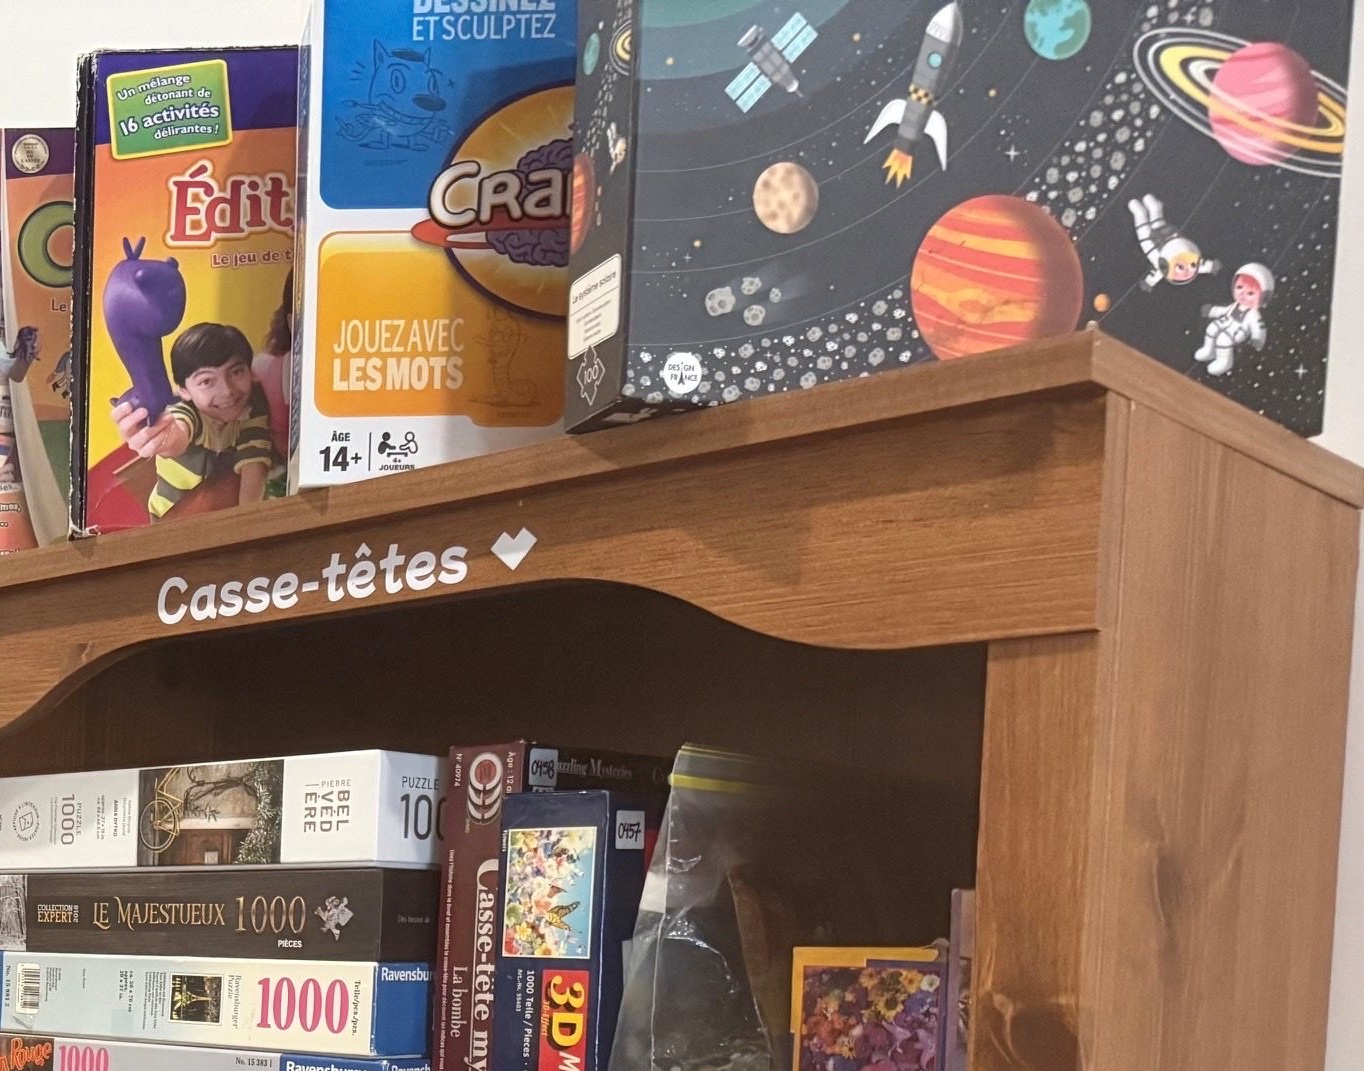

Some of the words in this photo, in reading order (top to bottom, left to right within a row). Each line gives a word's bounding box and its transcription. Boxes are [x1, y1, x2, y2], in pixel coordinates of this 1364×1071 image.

[413, 17, 439, 40] ET
[442, 14, 556, 40] SCULPTEZ
[118, 88, 136, 101] Un
[138, 74, 191, 93] mélange
[144, 89, 194, 106] détonant
[198, 88, 211, 98] de
[119, 119, 138, 136] 16
[143, 103, 220, 128] activités
[233, 252, 257, 267] jeu
[334, 318, 405, 354] JOUEZ
[408, 317, 463, 351] AVEC
[333, 358, 382, 391] LES
[386, 355, 463, 389] MOTS
[331, 430, 350, 441] ÂGE
[319, 446, 362, 472] 14+
[157, 542, 468, 626] Casse-têtes
[589, 758, 632, 778] Mysteries
[320, 779, 351, 788] PIERRE
[61, 794, 75, 845] 1000
[338, 789, 351, 831] BEL
[37, 904, 73, 913] COLLECTION
[37, 911, 73, 923] EXPERT
[93, 903, 111, 929] LE
[114, 896, 227, 930] MAJESTUEUX
[235, 896, 307, 934] 1000
[277, 938, 303, 948] PIÈCES
[474, 858, 499, 1021] Casse-tête
[452, 966, 468, 985] La
[526, 970, 535, 994] 1000
[257, 977, 349, 1034] 1000
[450, 989, 468, 1038] bombe
[549, 975, 585, 1048] 3D
[248, 1057, 255, 1066] 15
[256, 1058, 268, 1067] 383
